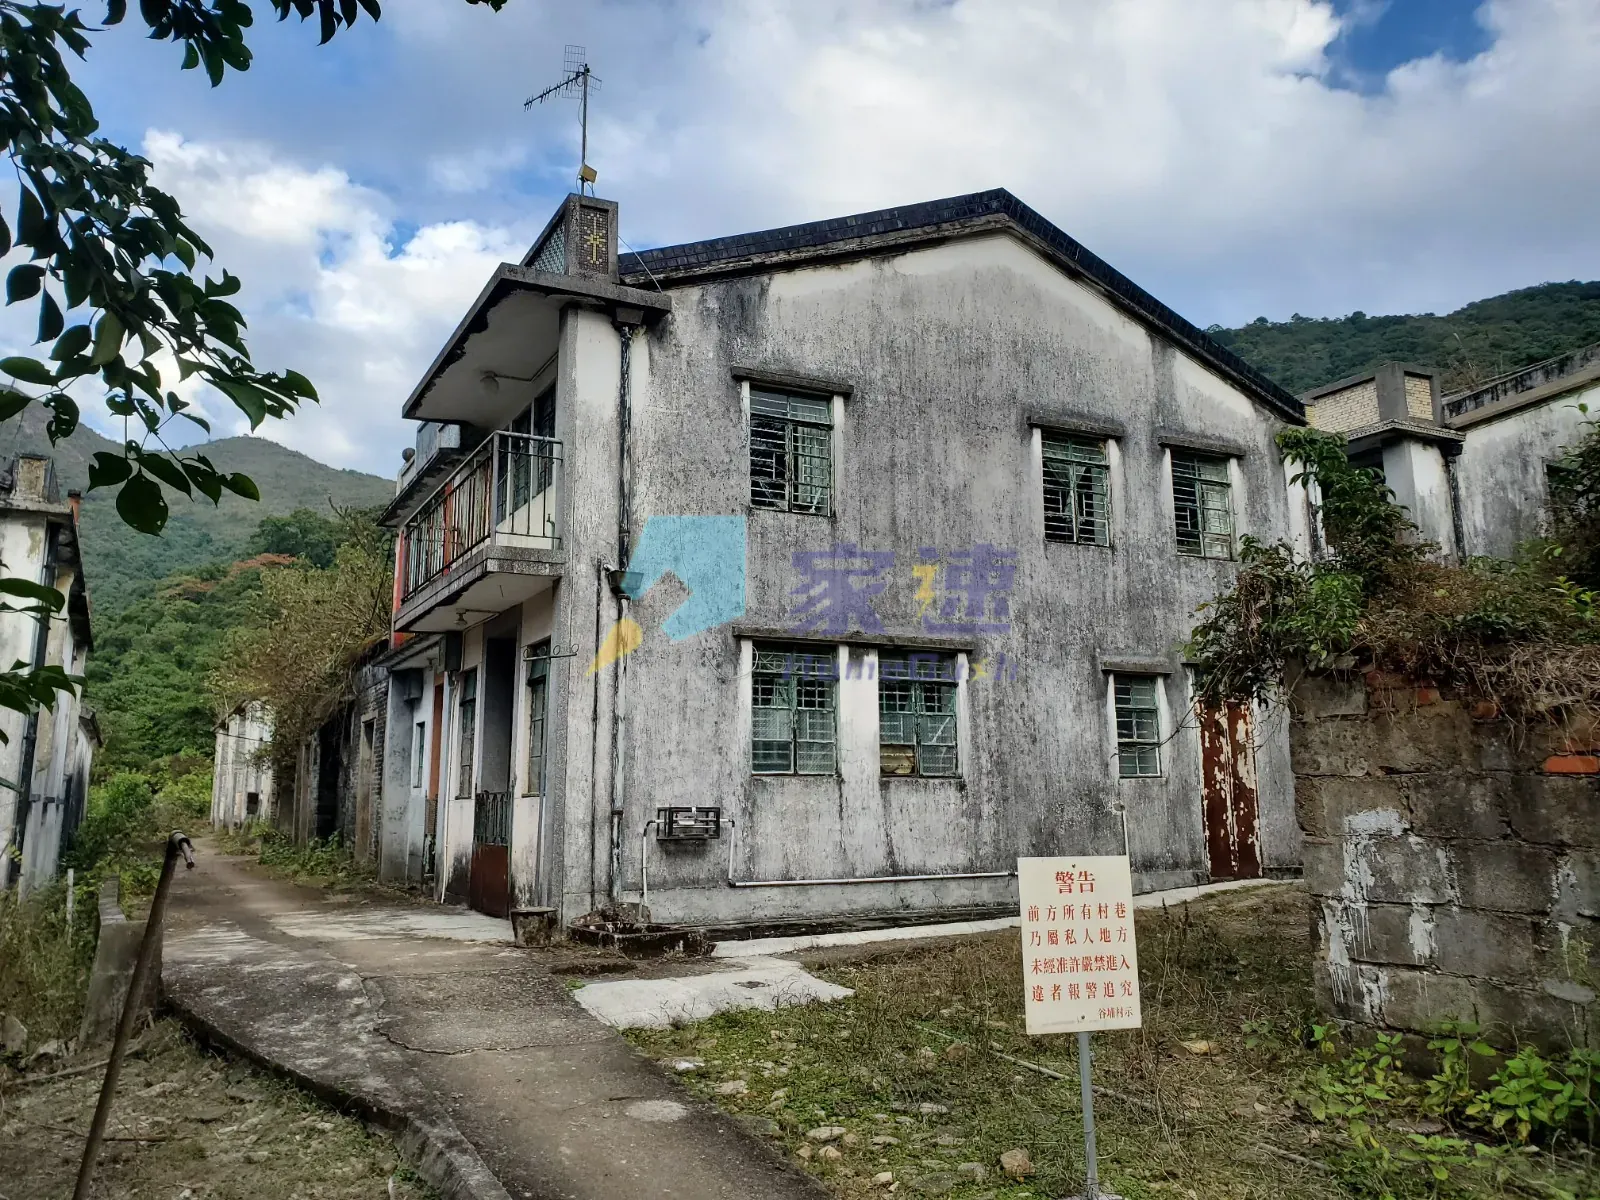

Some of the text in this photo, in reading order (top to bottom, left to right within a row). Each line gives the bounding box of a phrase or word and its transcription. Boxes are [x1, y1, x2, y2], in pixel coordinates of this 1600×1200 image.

[1055, 871, 1096, 894] 警告
[1028, 902, 1127, 923] 前方所有村巷
[1029, 926, 1128, 947] 乃屬私人地方
[1031, 954, 1131, 975] 未經准許嚴禁進入
[1032, 980, 1133, 1002] 違者報警追究
